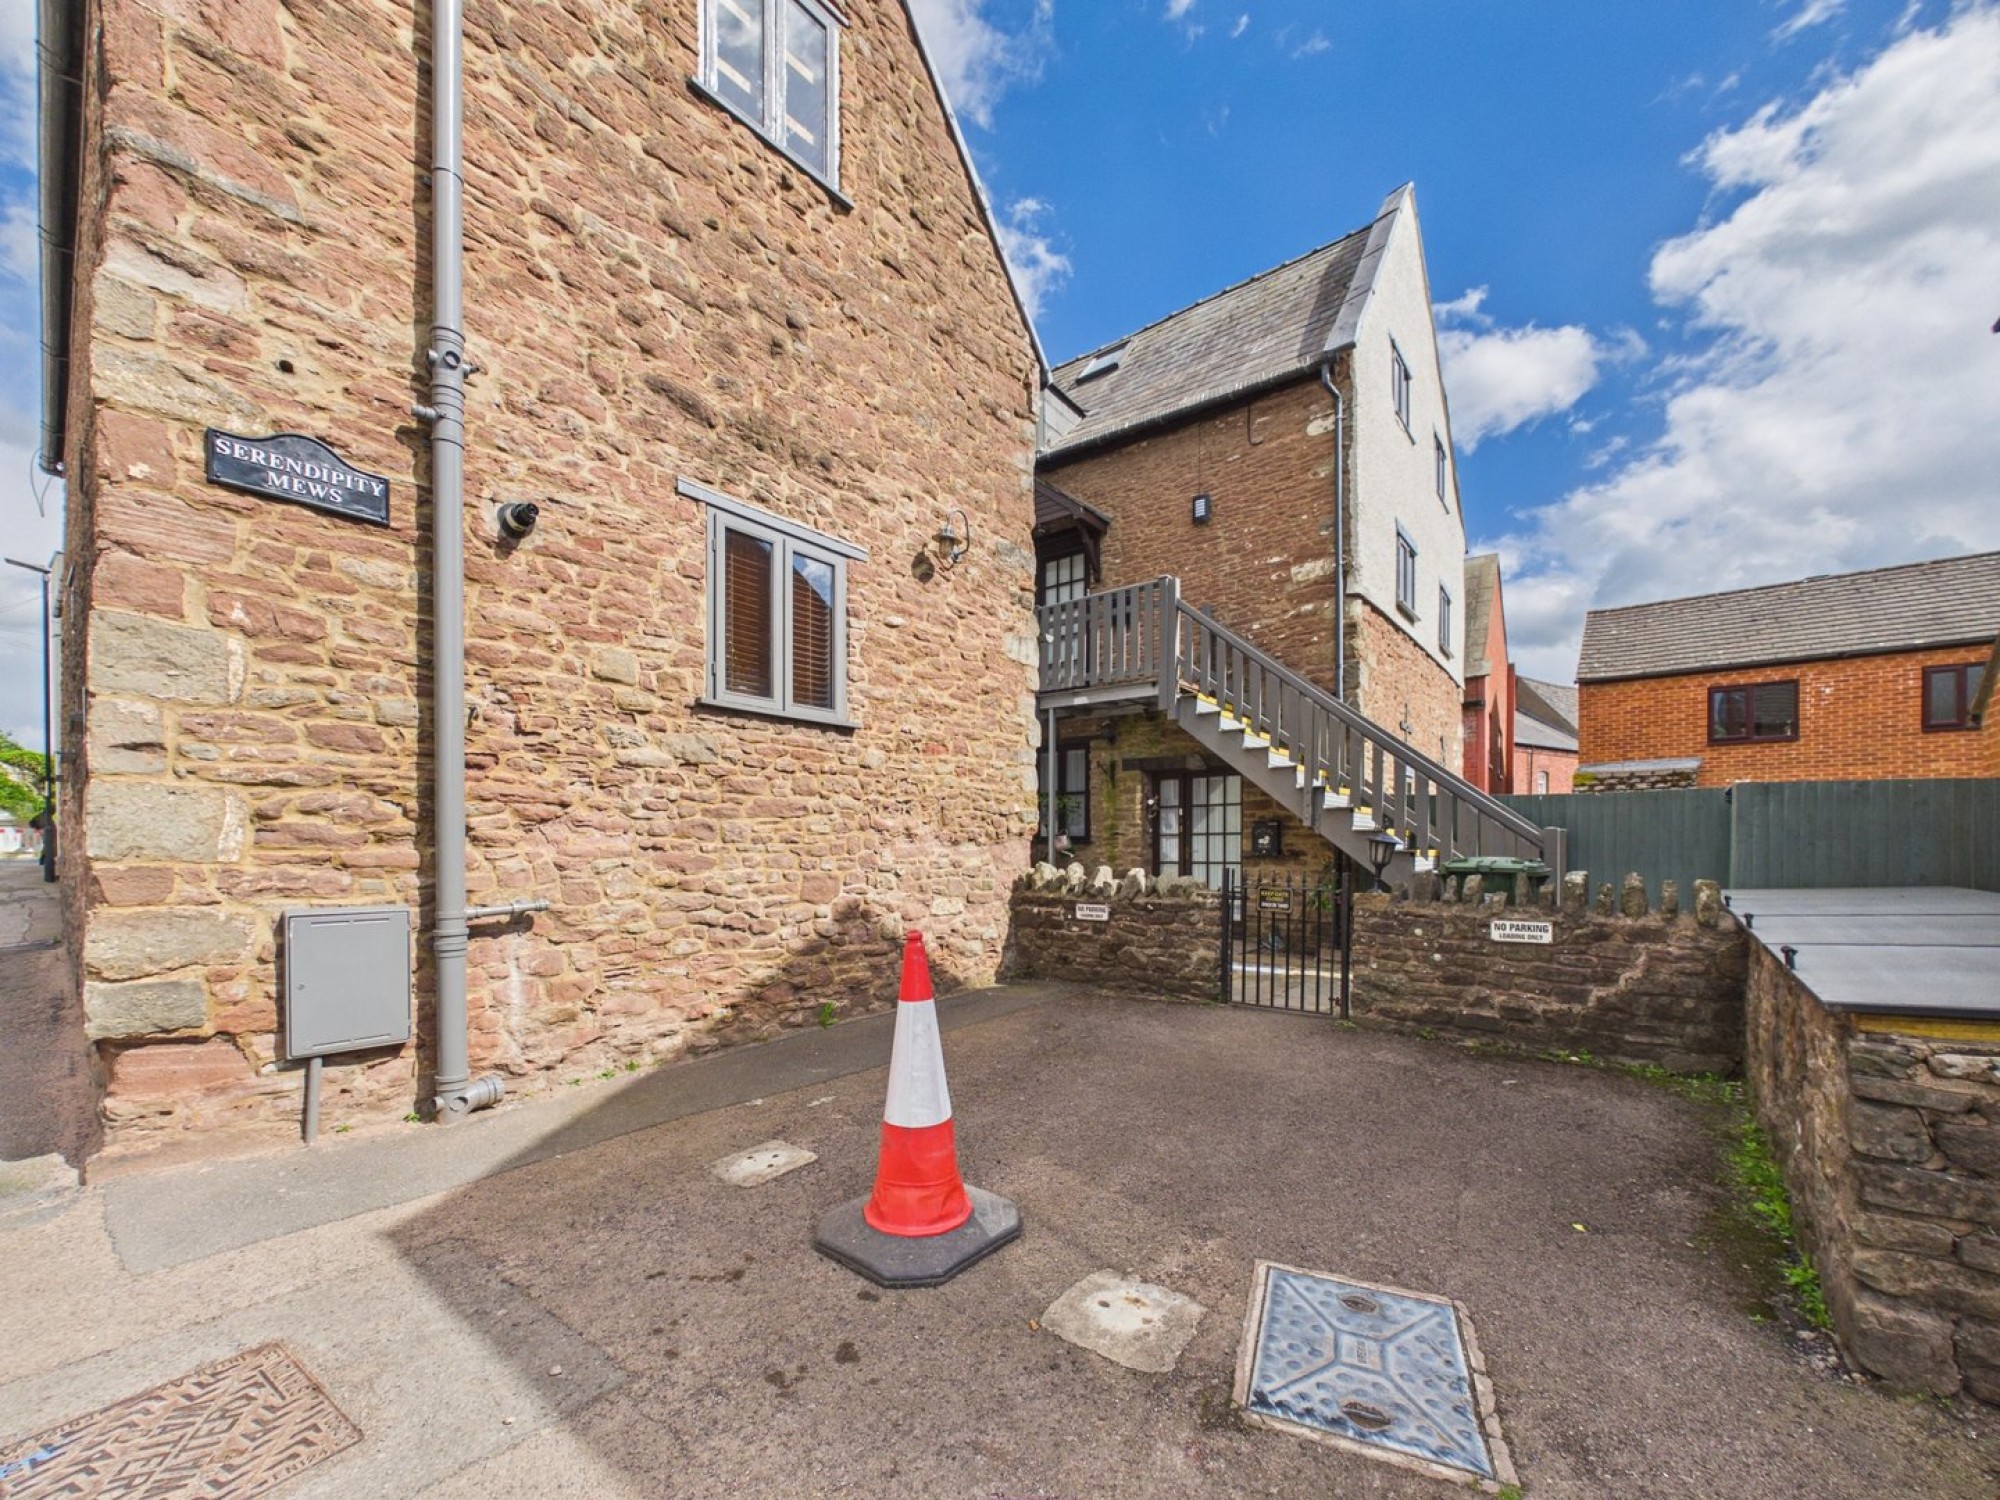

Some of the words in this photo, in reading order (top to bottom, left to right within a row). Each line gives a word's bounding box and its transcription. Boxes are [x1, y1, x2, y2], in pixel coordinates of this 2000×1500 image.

[215, 438, 385, 497] SERENDIPITY
[266, 471, 343, 503] MEWS
[1494, 923, 1507, 932] NO
[1509, 924, 1549, 933] PARKING
